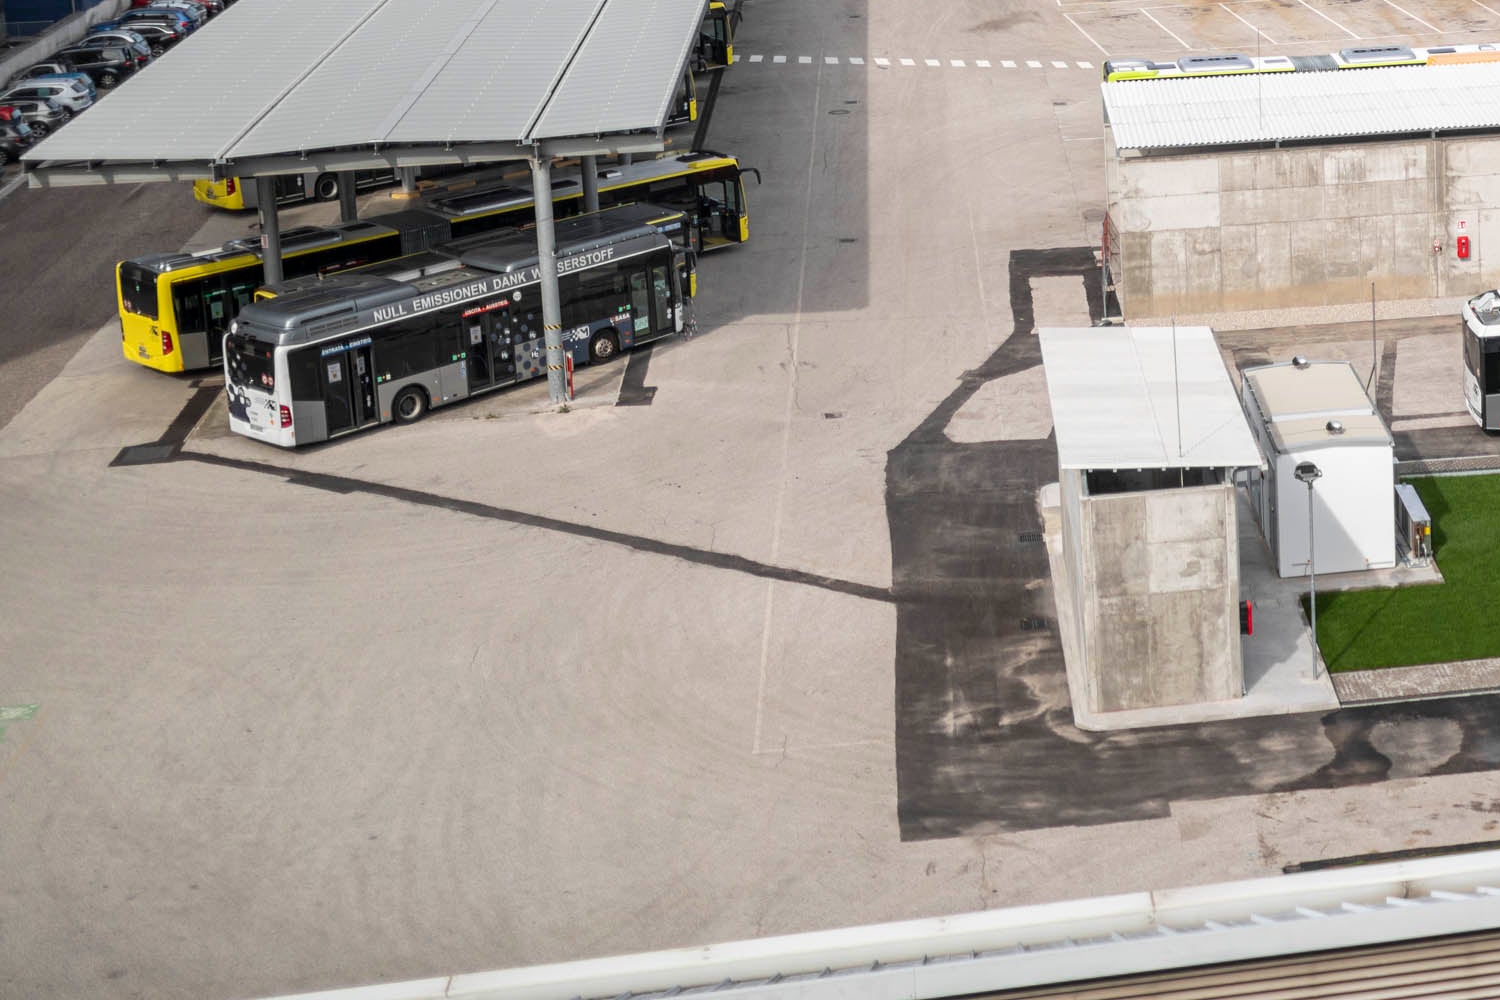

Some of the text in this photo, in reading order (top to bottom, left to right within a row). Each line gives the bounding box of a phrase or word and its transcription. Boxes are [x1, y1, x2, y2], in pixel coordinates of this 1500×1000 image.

[373, 248, 614, 323] NULL EMISSIONEN DANK WSERSTOFF
